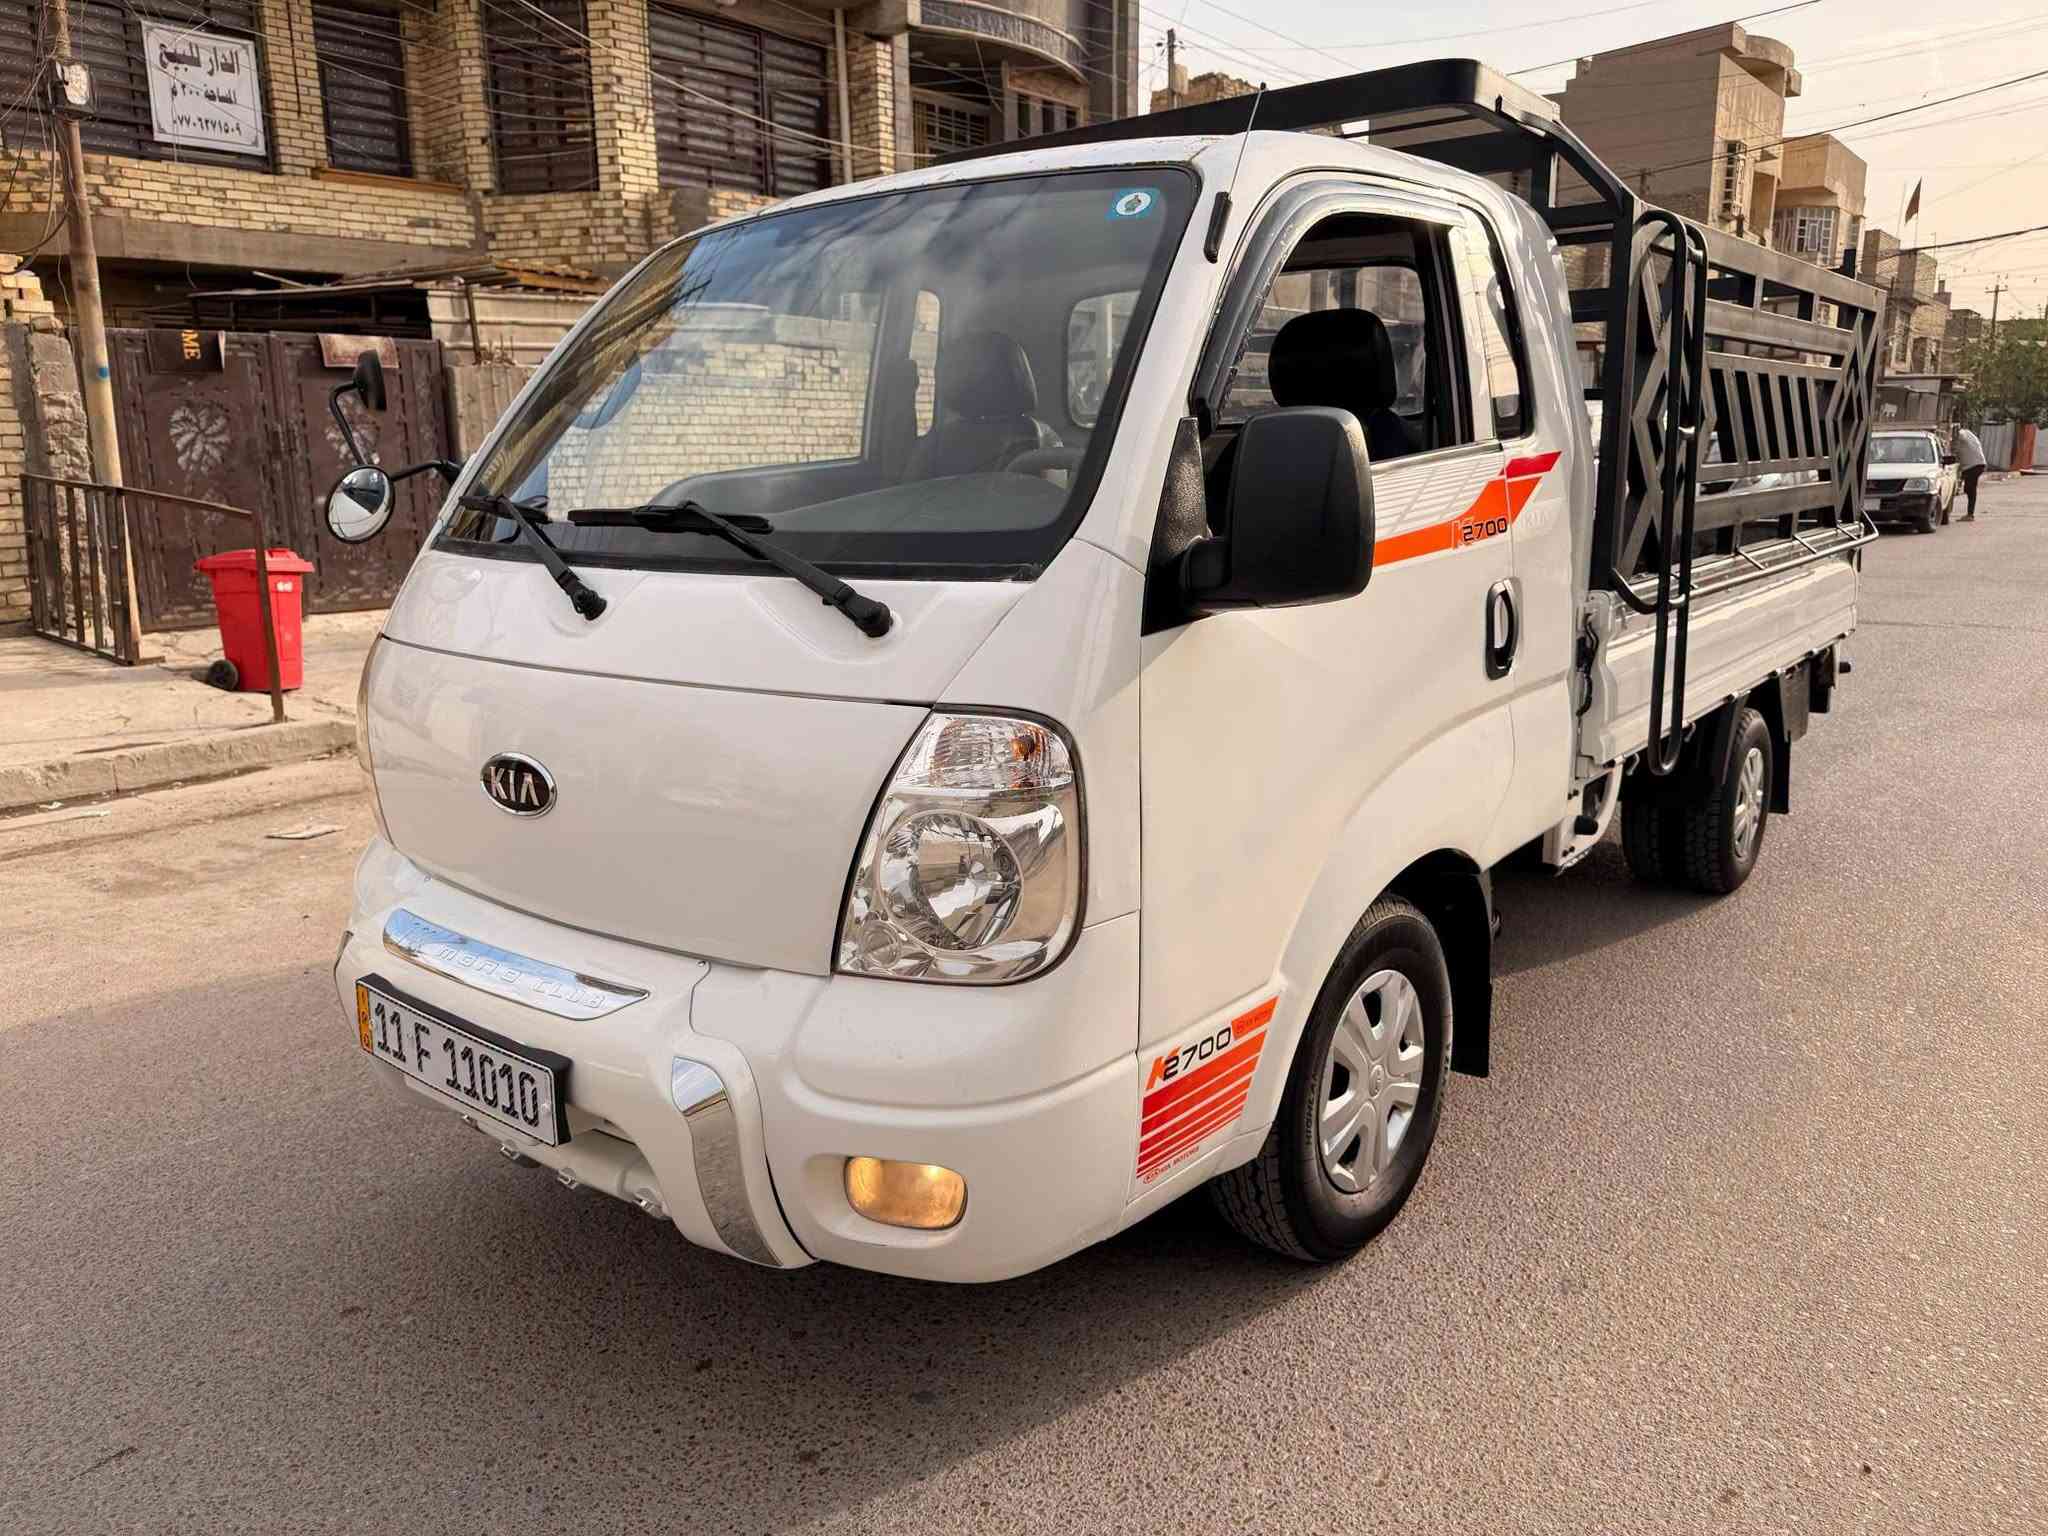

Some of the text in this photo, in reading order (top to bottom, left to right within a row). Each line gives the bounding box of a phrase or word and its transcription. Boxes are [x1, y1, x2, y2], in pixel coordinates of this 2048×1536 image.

[159, 41, 240, 77] الدار للبيع
[204, 83, 237, 105] المساحة
[489, 766, 541, 806] KIA
[375, 1002, 540, 1127] 11 F 11010
